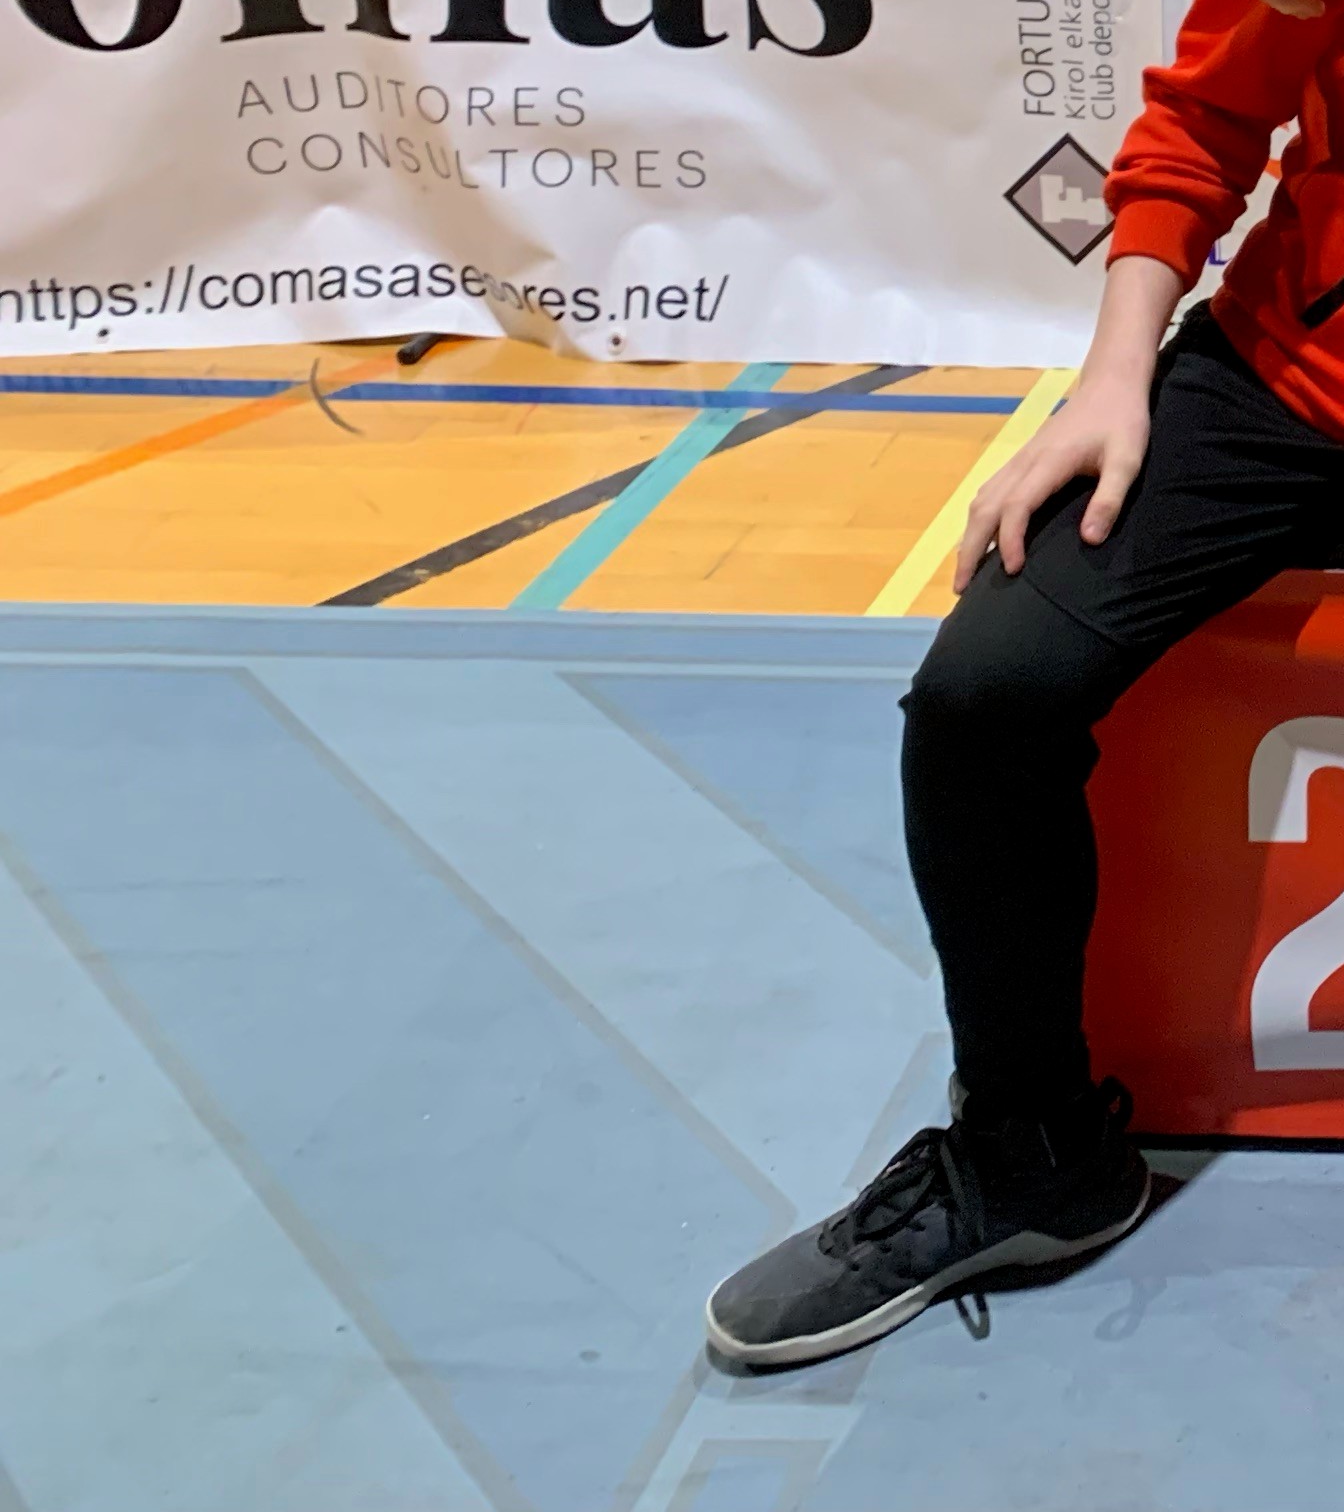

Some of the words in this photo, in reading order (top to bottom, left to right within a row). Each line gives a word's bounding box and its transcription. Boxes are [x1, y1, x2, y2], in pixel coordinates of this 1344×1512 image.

[238, 71, 586, 127] AUDITORES
[1062, 59, 1086, 120] Kirol
[1089, 64, 1116, 120] Club
[246, 131, 708, 189] CONSULTORES
